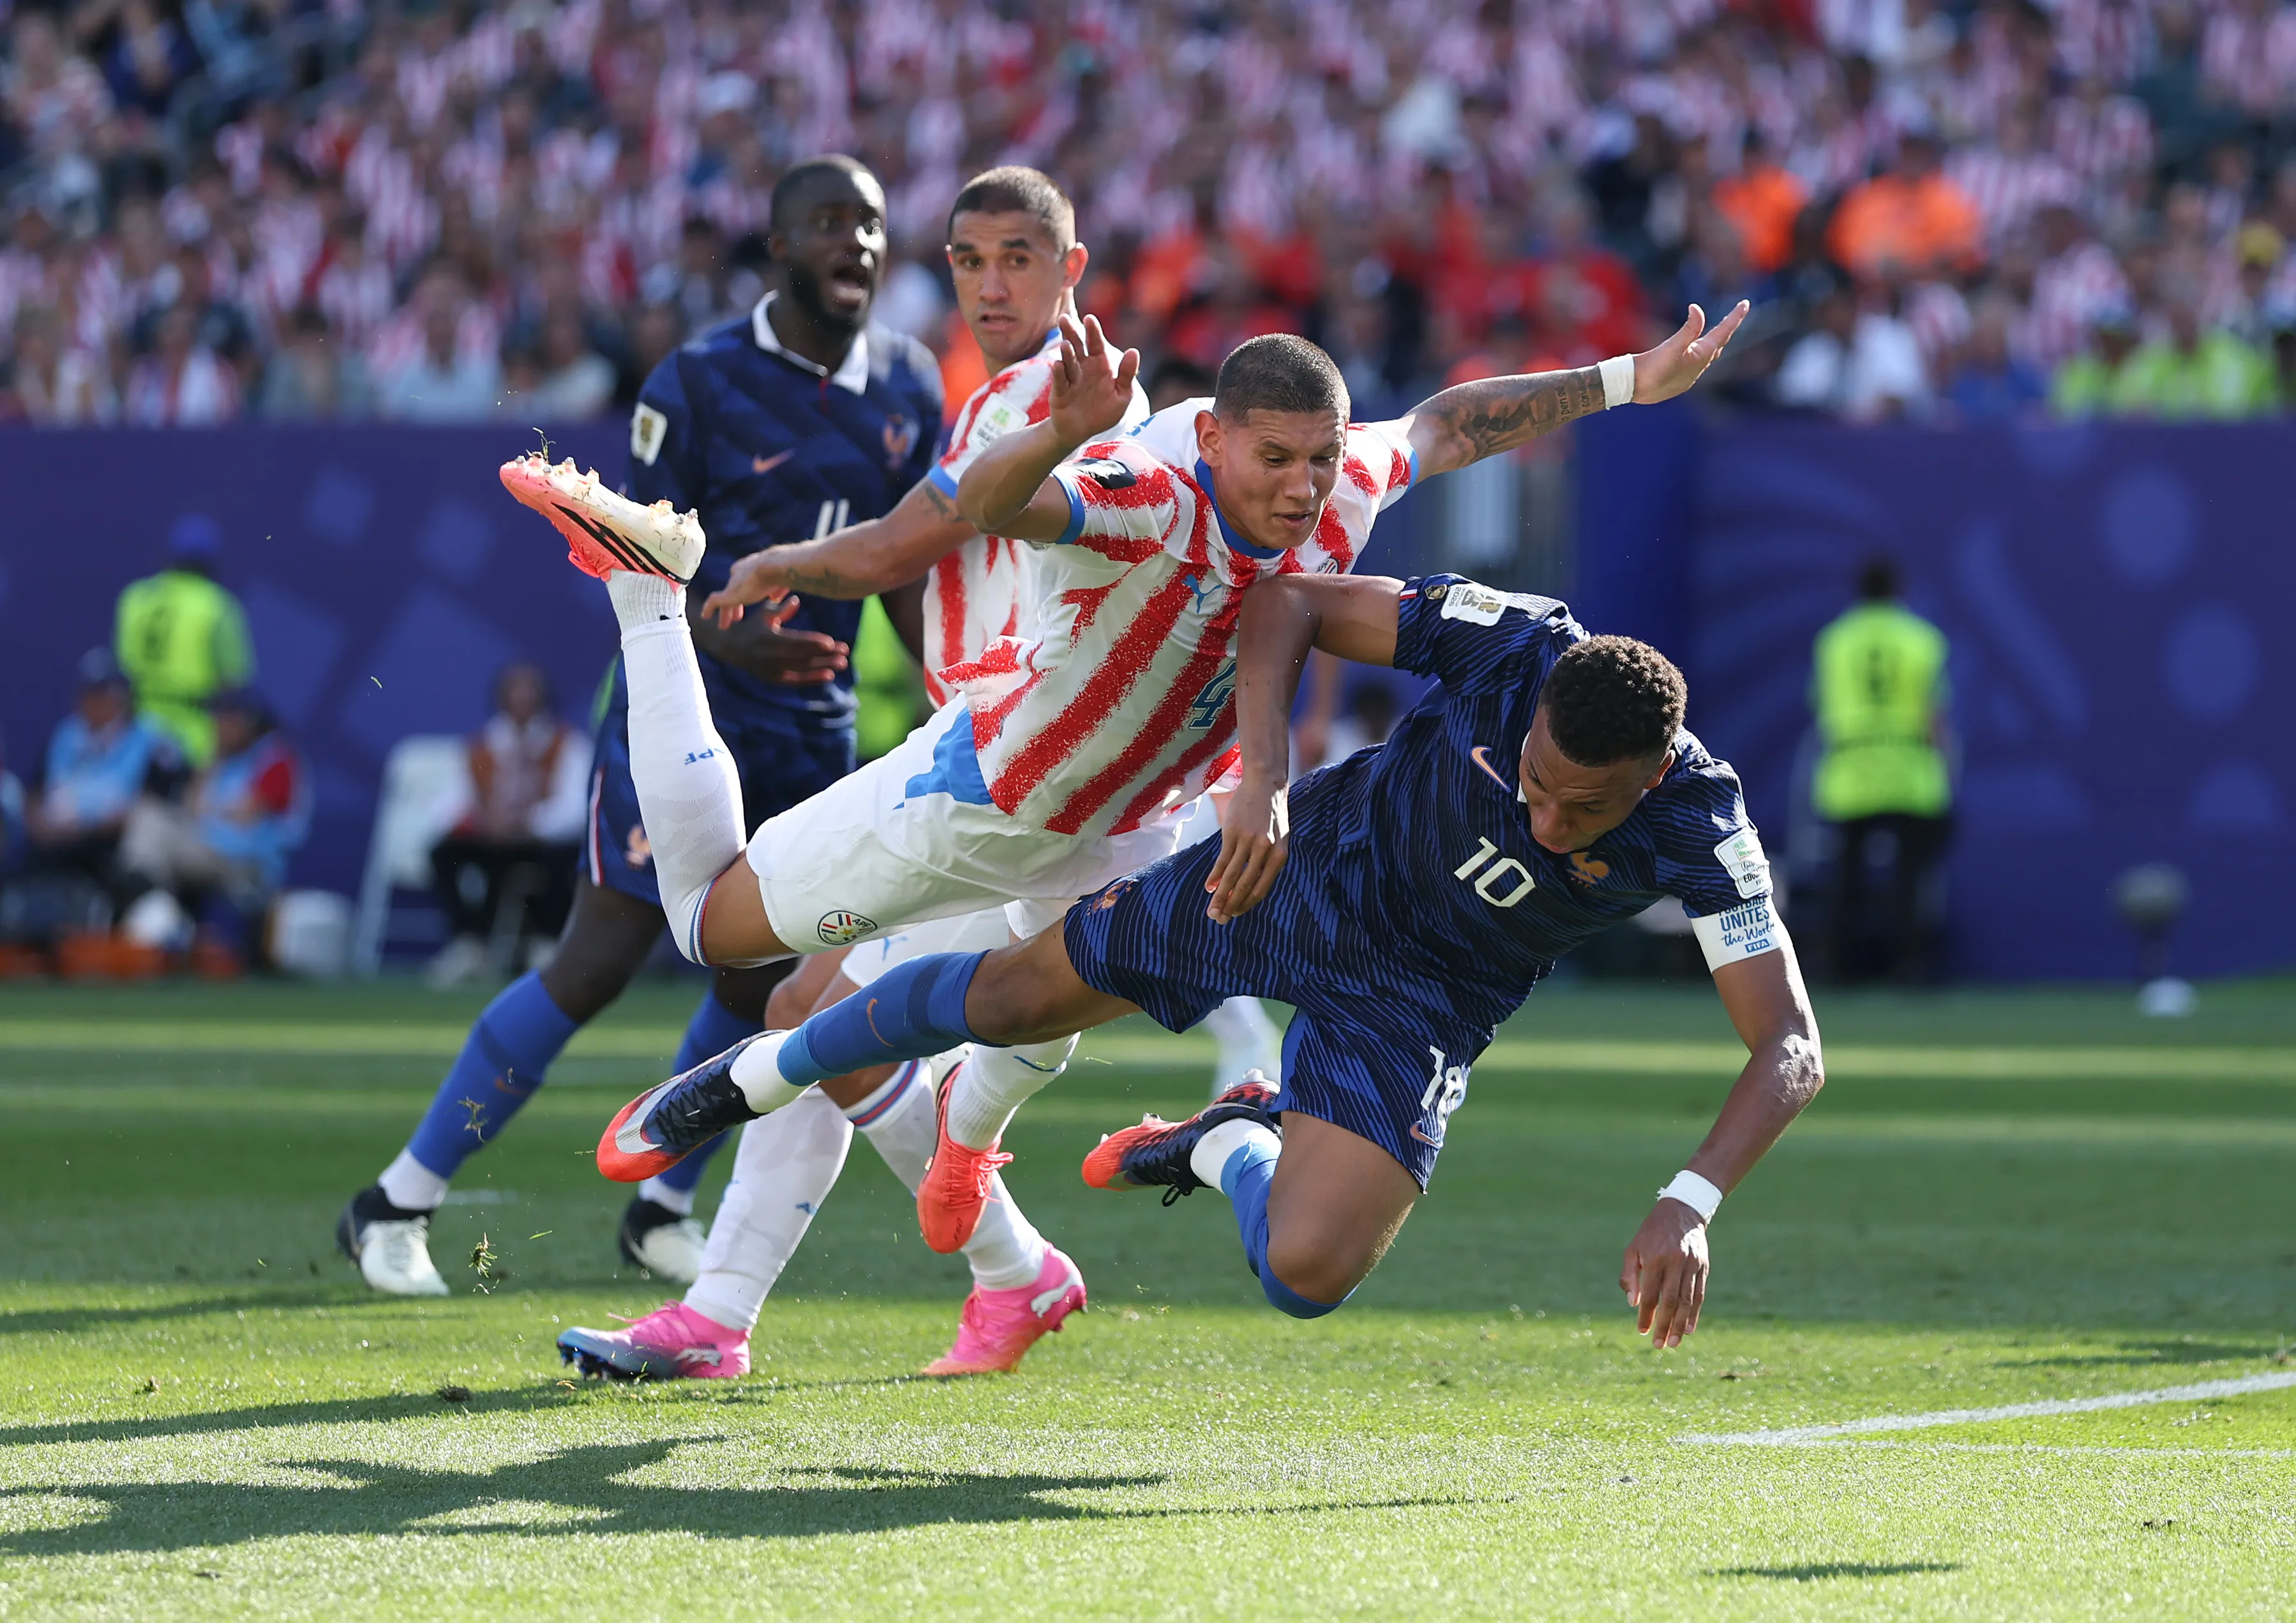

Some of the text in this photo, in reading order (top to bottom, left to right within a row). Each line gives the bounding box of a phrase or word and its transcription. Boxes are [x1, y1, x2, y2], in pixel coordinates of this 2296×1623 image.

[1449, 587, 1462, 606] 2026
[1188, 659, 1236, 729] 4
[1453, 836, 1536, 907] 10
[852, 918, 871, 928] APF
[1720, 904, 1769, 932] UNITES
[1721, 932, 1745, 946] the
[1746, 939, 1769, 952] FIFA
